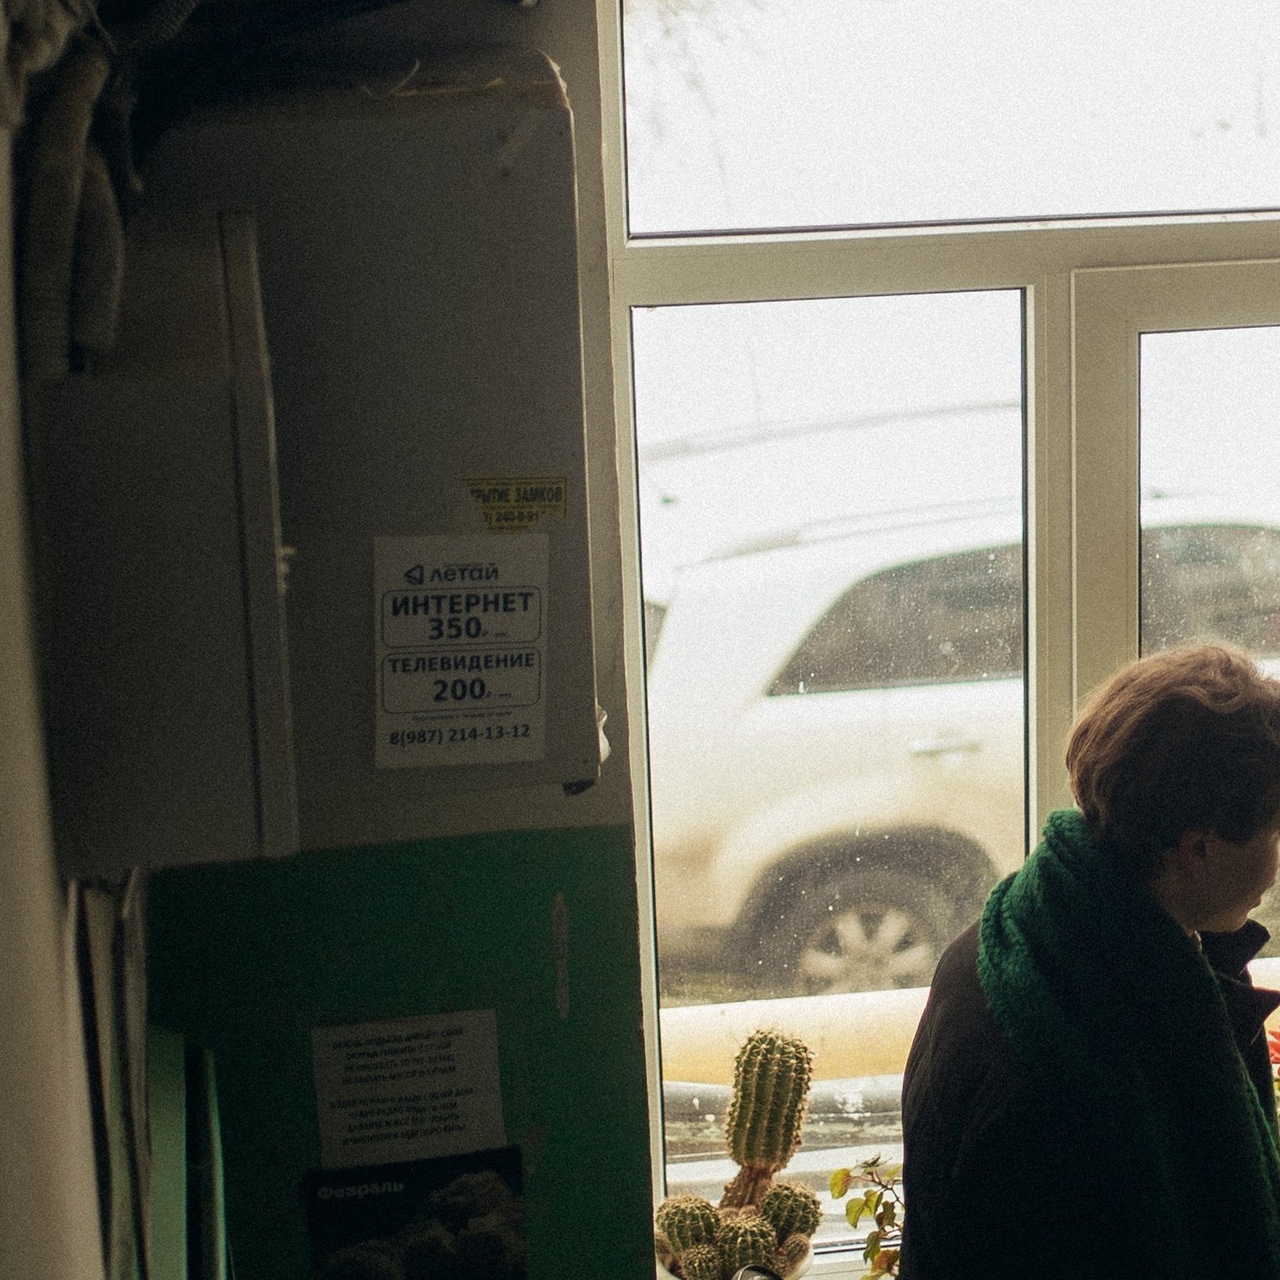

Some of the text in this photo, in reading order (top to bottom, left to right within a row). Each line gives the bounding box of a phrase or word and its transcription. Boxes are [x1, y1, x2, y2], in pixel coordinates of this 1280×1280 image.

[515, 486, 562, 502] ЗАМКОВ
[391, 592, 533, 616] ИНТЕРНЕТ
[428, 617, 482, 640] 350
[388, 653, 535, 674] ТЕЛЕВИДЕНИЕ
[433, 678, 486, 702] 200
[389, 724, 531, 748] 8(987) 214-13-12
[317, 1181, 405, 1201] Февраль
